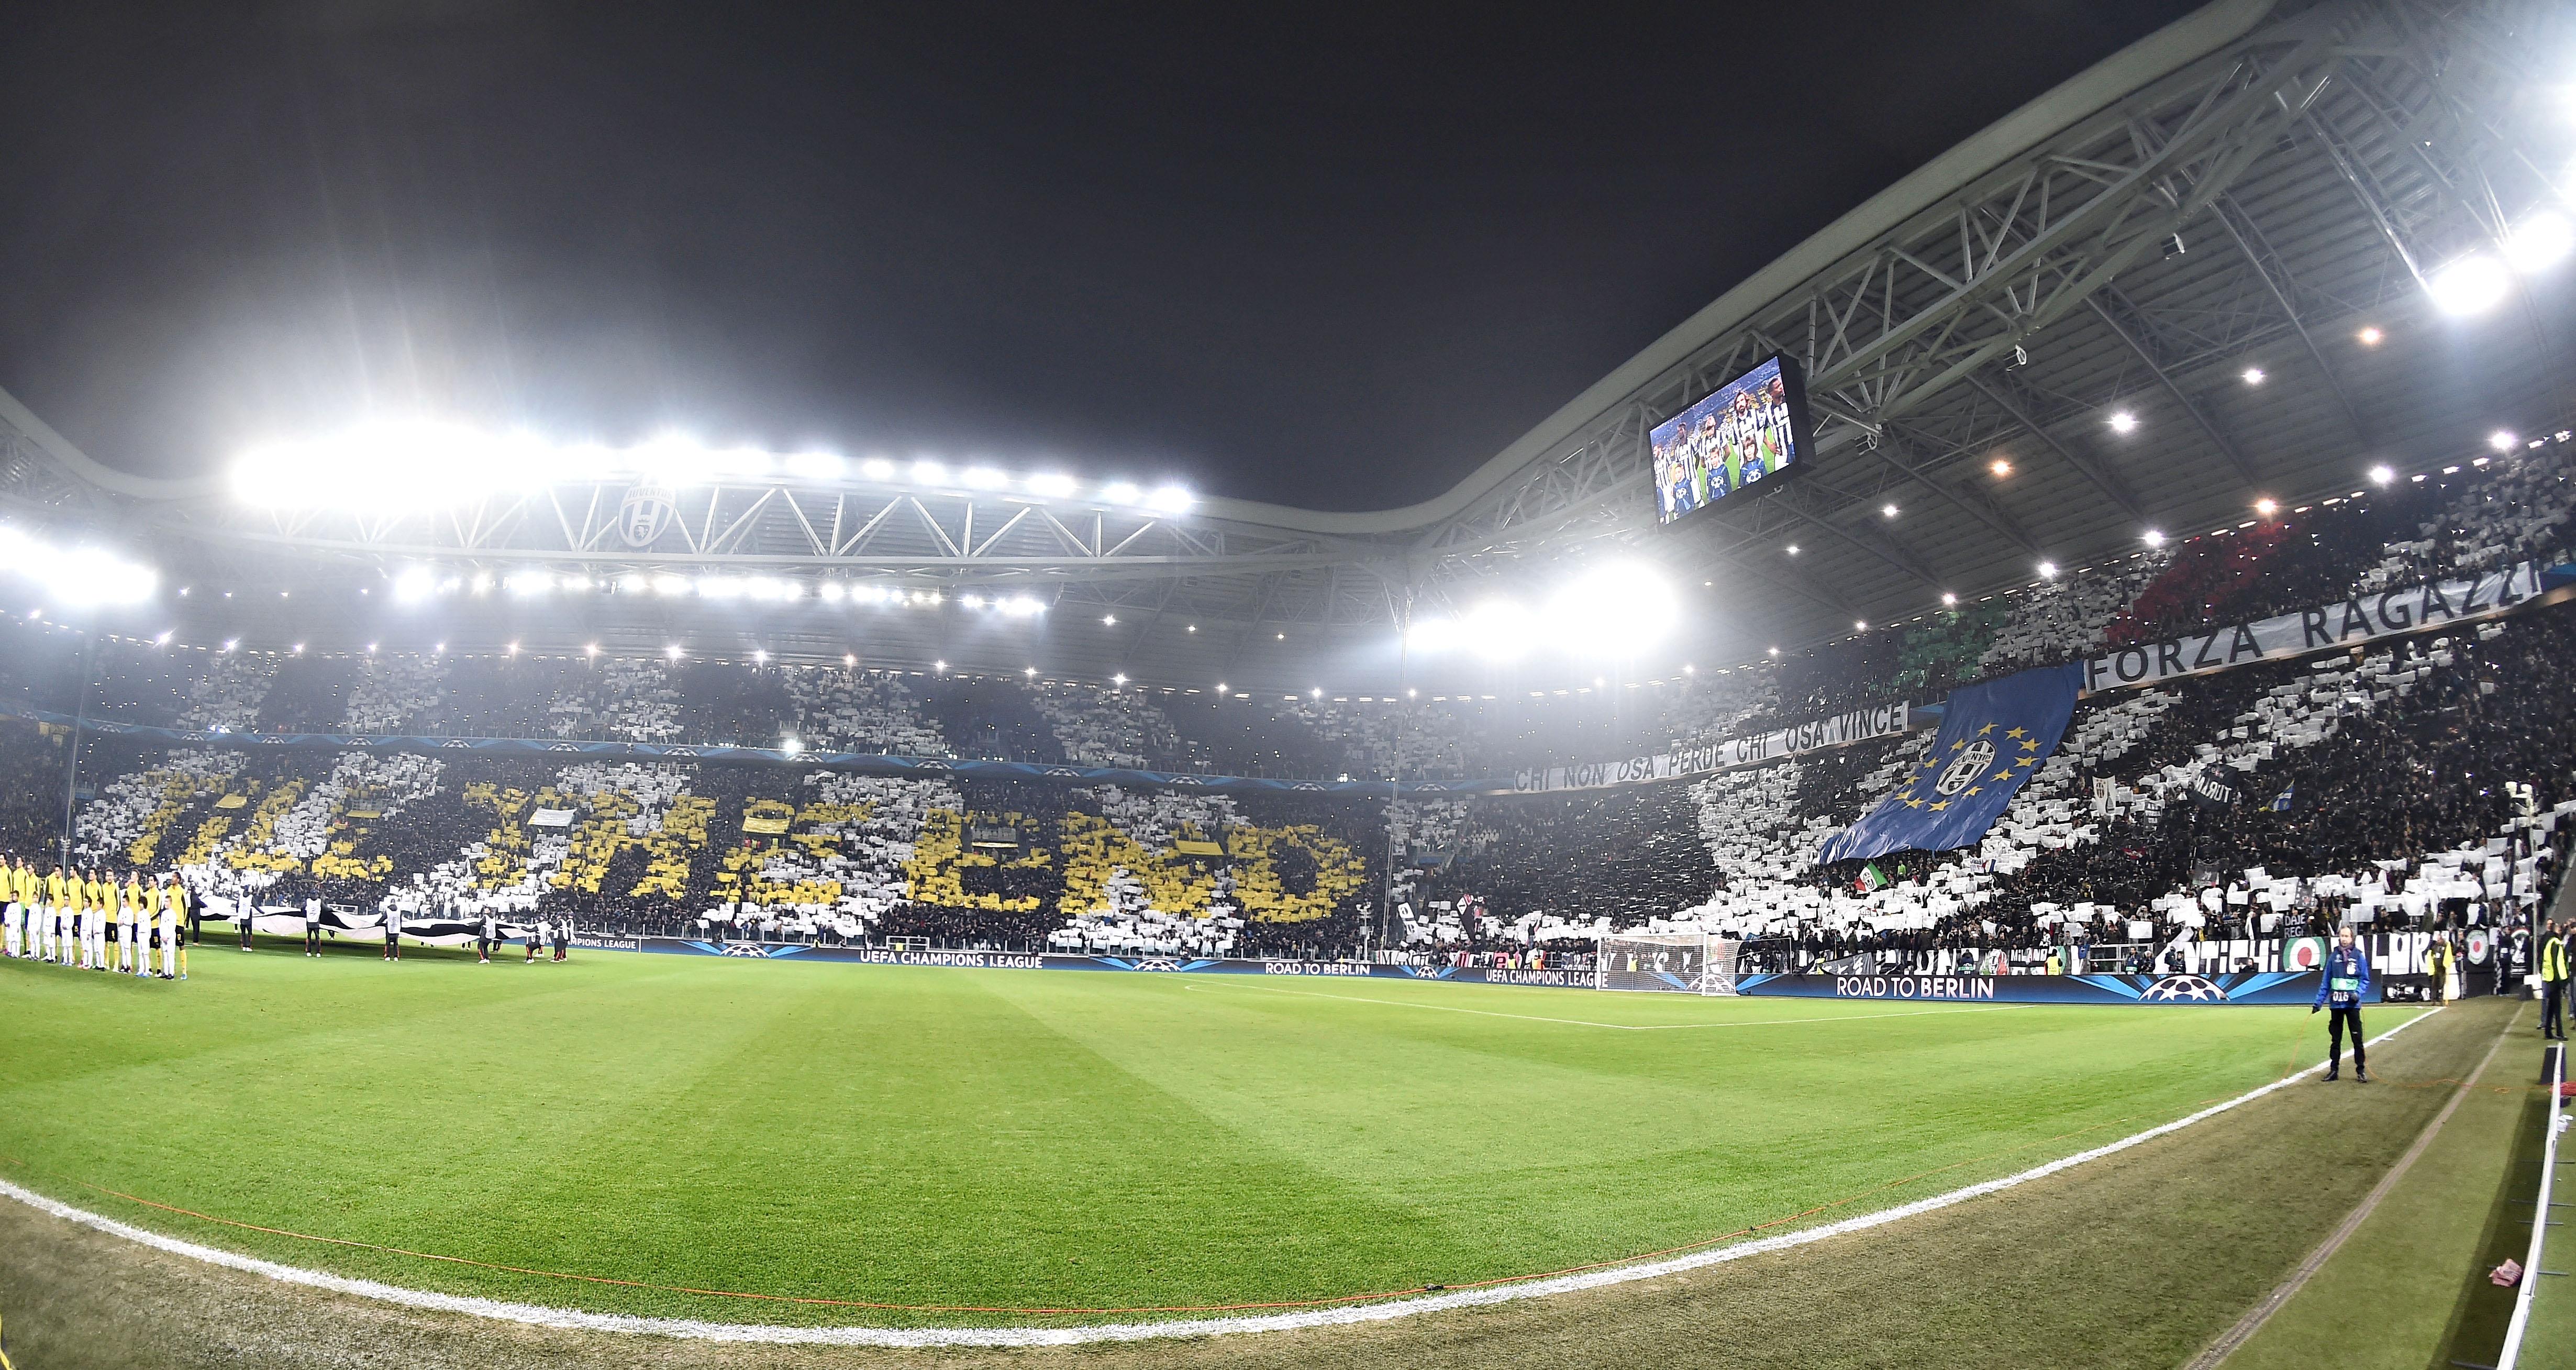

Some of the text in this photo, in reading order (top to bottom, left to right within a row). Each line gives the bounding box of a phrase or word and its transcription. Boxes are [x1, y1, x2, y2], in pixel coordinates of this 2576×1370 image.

[2088, 559, 2540, 690] FORZA RAGAZZI
[1515, 705, 1903, 791] CHI NON OSA PERDE CHI OSA VINCE
[604, 940, 636, 949] LEAGUE
[860, 950, 1043, 968] UEFA CHAMPIONS LEAGUE
[1265, 963, 1370, 975] ROAD TO BERLIN
[1486, 969, 1508, 983] UEFA
[1509, 970, 1564, 986] CHAMPIONS
[1837, 976, 1994, 999] ROAD TO BERLIN
